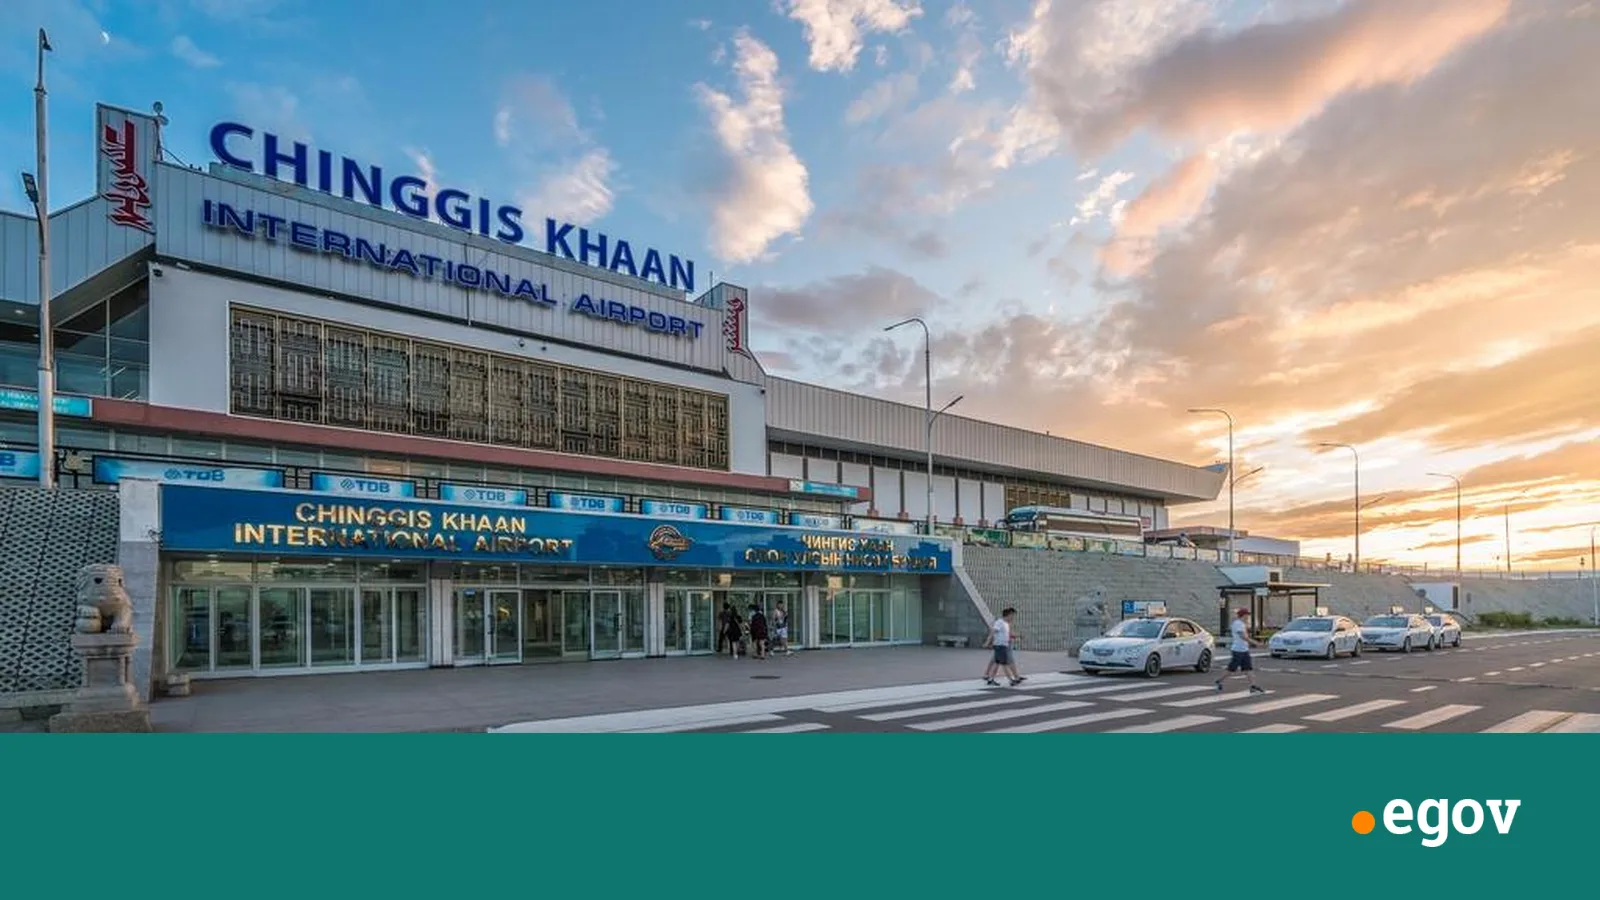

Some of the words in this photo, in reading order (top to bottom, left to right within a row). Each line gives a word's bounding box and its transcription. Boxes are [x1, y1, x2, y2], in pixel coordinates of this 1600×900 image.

[209, 121, 524, 244] CHINGGIS
[546, 217, 694, 293] KHAAN
[203, 199, 557, 305] INTERNATIONAL
[574, 294, 705, 339] AIRPORT
[183, 469, 225, 481] TDB
[355, 480, 390, 493] TDB
[477, 489, 505, 501] TDB
[579, 497, 605, 509] TDB
[295, 502, 432, 529] CHINGGIS
[442, 511, 526, 534] KHAAN
[234, 522, 462, 552] INTERNATIONAL
[474, 535, 573, 555] AIRPORT
[801, 535, 856, 551] ЧИНГИС
